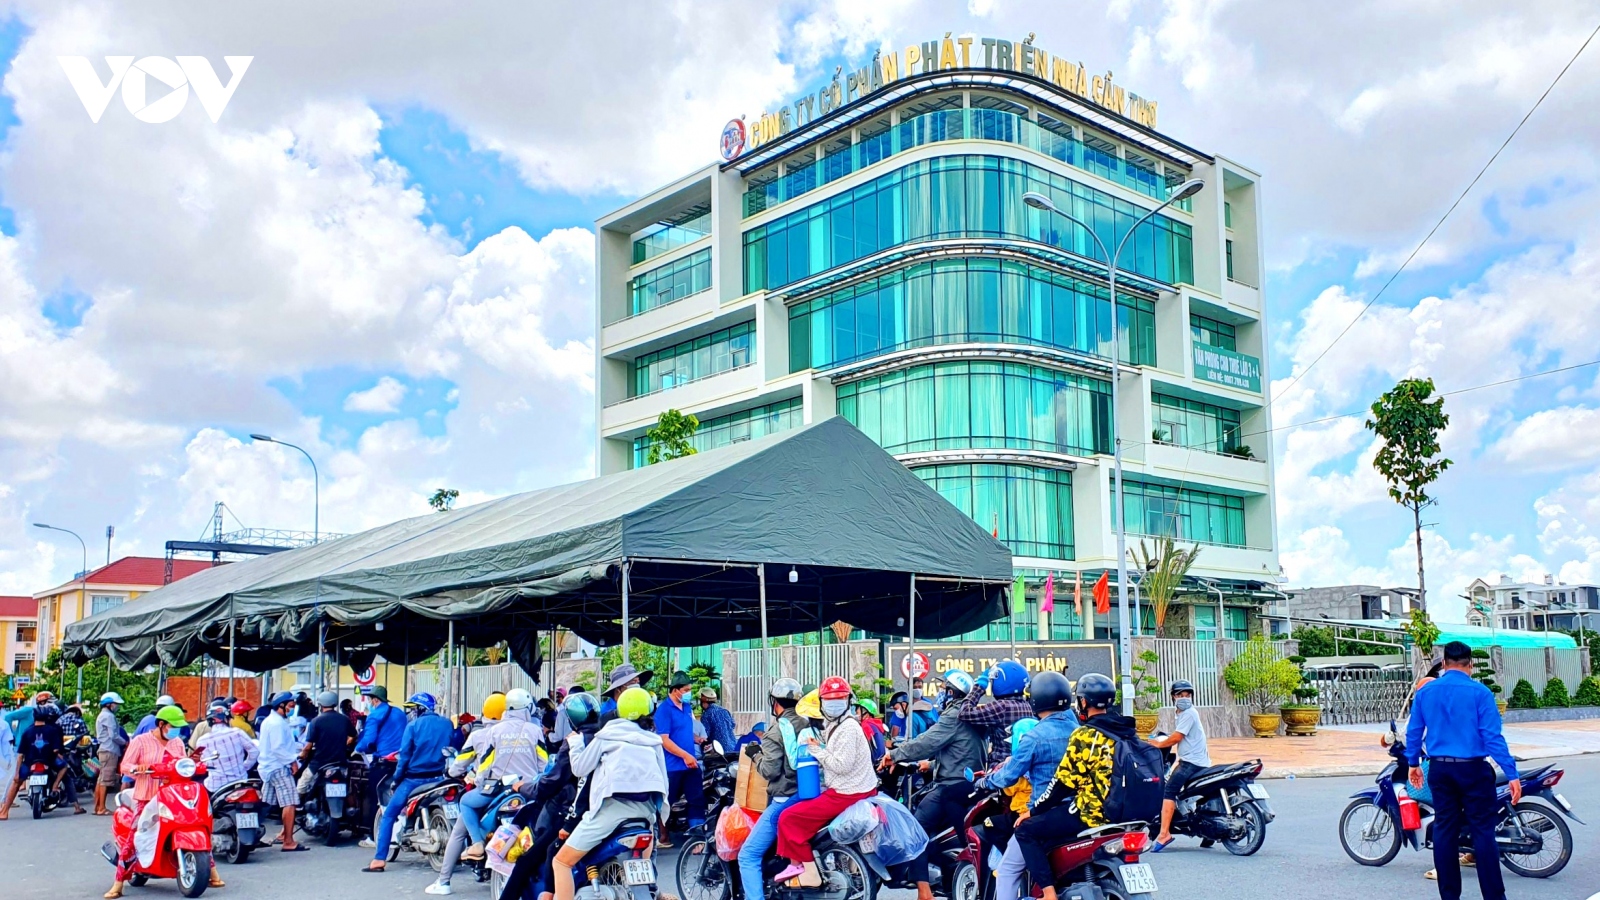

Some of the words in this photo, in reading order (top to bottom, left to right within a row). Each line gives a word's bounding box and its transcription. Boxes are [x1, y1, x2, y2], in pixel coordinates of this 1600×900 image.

[749, 105, 791, 149] CÔNG
[794, 93, 815, 127] TY
[818, 65, 842, 115] CỔ
[846, 48, 898, 103] PHẦN
[904, 31, 973, 77] PHÁT
[981, 31, 1048, 79] TRIỂN
[1052, 55, 1088, 99] NHÀ
[1092, 70, 1125, 116] CẦN
[935, 654, 974, 673] CÔNG
[1025, 651, 1067, 672] PHẦN
[630, 872, 652, 883] 1401
[1125, 866, 1148, 878] 64-B1
